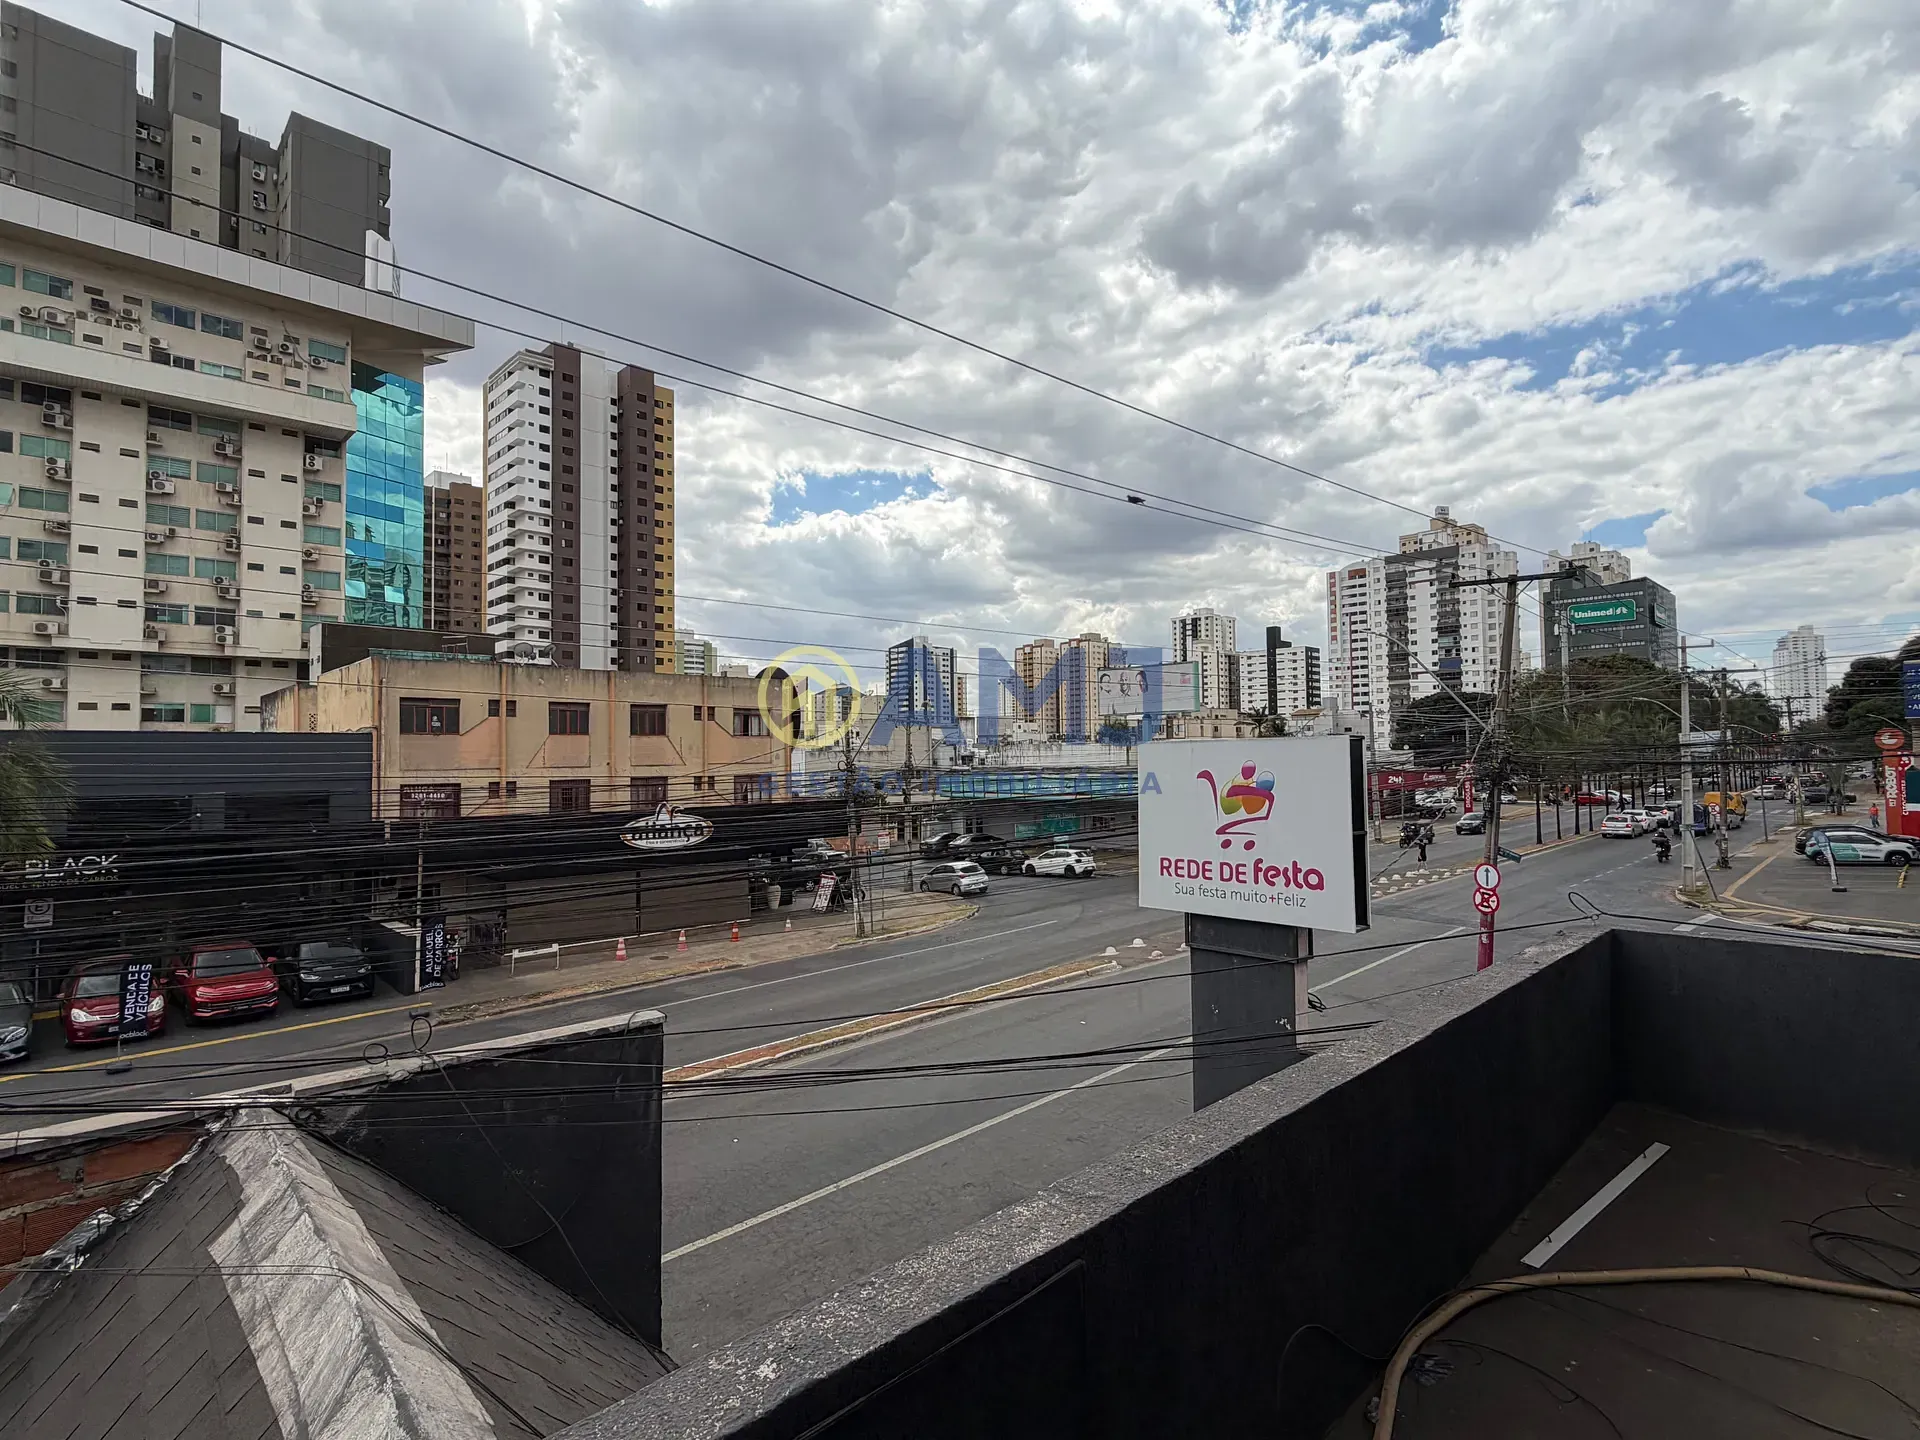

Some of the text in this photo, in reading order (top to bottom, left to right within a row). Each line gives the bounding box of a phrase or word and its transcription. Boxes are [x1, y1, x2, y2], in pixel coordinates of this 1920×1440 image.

[1574, 608, 1613, 618] Unimed
[1159, 857, 1325, 891] REDE DE festa
[1174, 882, 1195, 896] Sua
[1198, 884, 1227, 899] festa
[434, 924, 444, 976] DE CARROS
[123, 964, 140, 1023] VENDA DE
